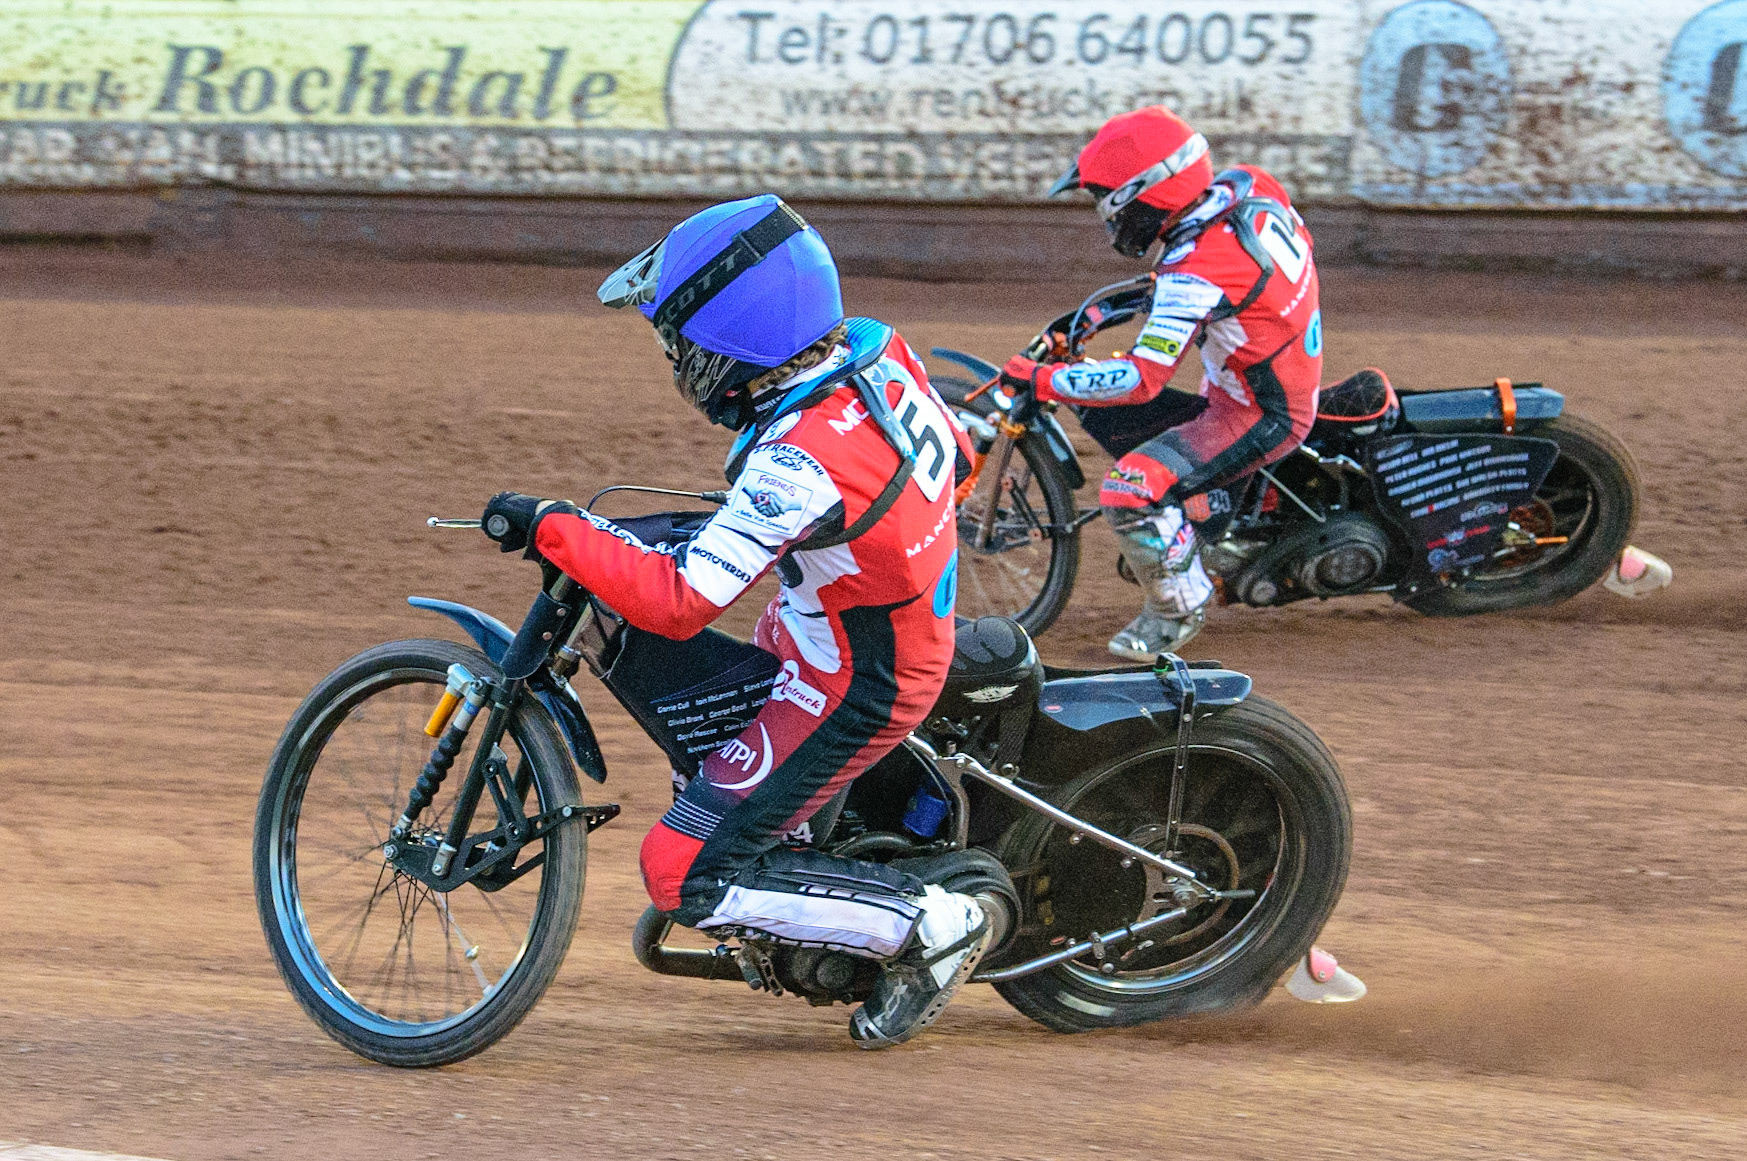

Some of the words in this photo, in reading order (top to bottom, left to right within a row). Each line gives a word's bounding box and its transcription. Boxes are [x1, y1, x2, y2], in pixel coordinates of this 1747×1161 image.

[0, 69, 126, 115] uck
[150, 44, 619, 121] Rochdale
[659, 246, 742, 324] COTT
[1067, 368, 1128, 392] FRP
[899, 400, 945, 482] 5
[757, 473, 798, 497] FRIENDS
